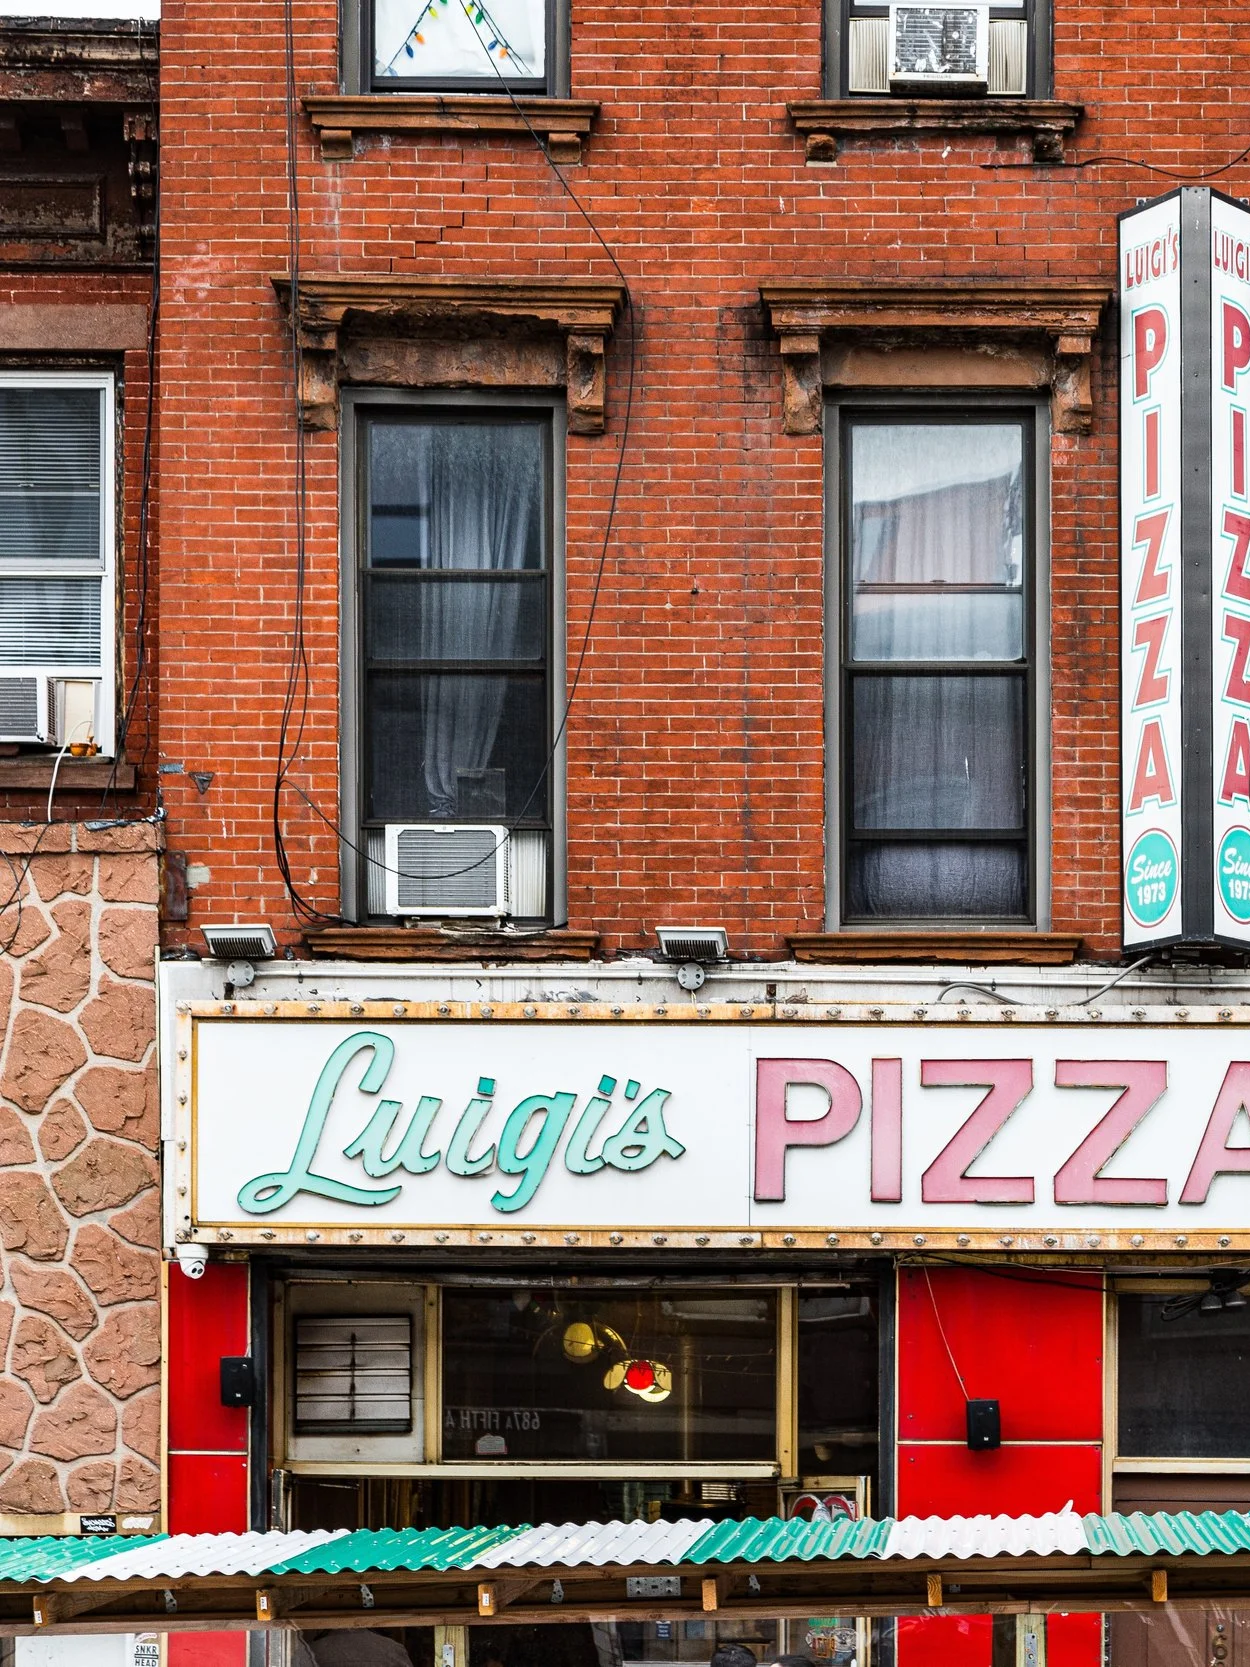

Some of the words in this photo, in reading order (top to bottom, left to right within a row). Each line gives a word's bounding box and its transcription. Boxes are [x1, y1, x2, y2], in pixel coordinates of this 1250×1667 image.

[1125, 224, 1180, 291] LUIGI'S
[1126, 303, 1177, 817] PIZZA
[1131, 853, 1173, 885] Since
[1136, 881, 1167, 906] 1973
[236, 1031, 687, 1214] Luigi's
[134, 1658, 157, 1667] HEAD
[135, 1645, 157, 1655] SNKR
